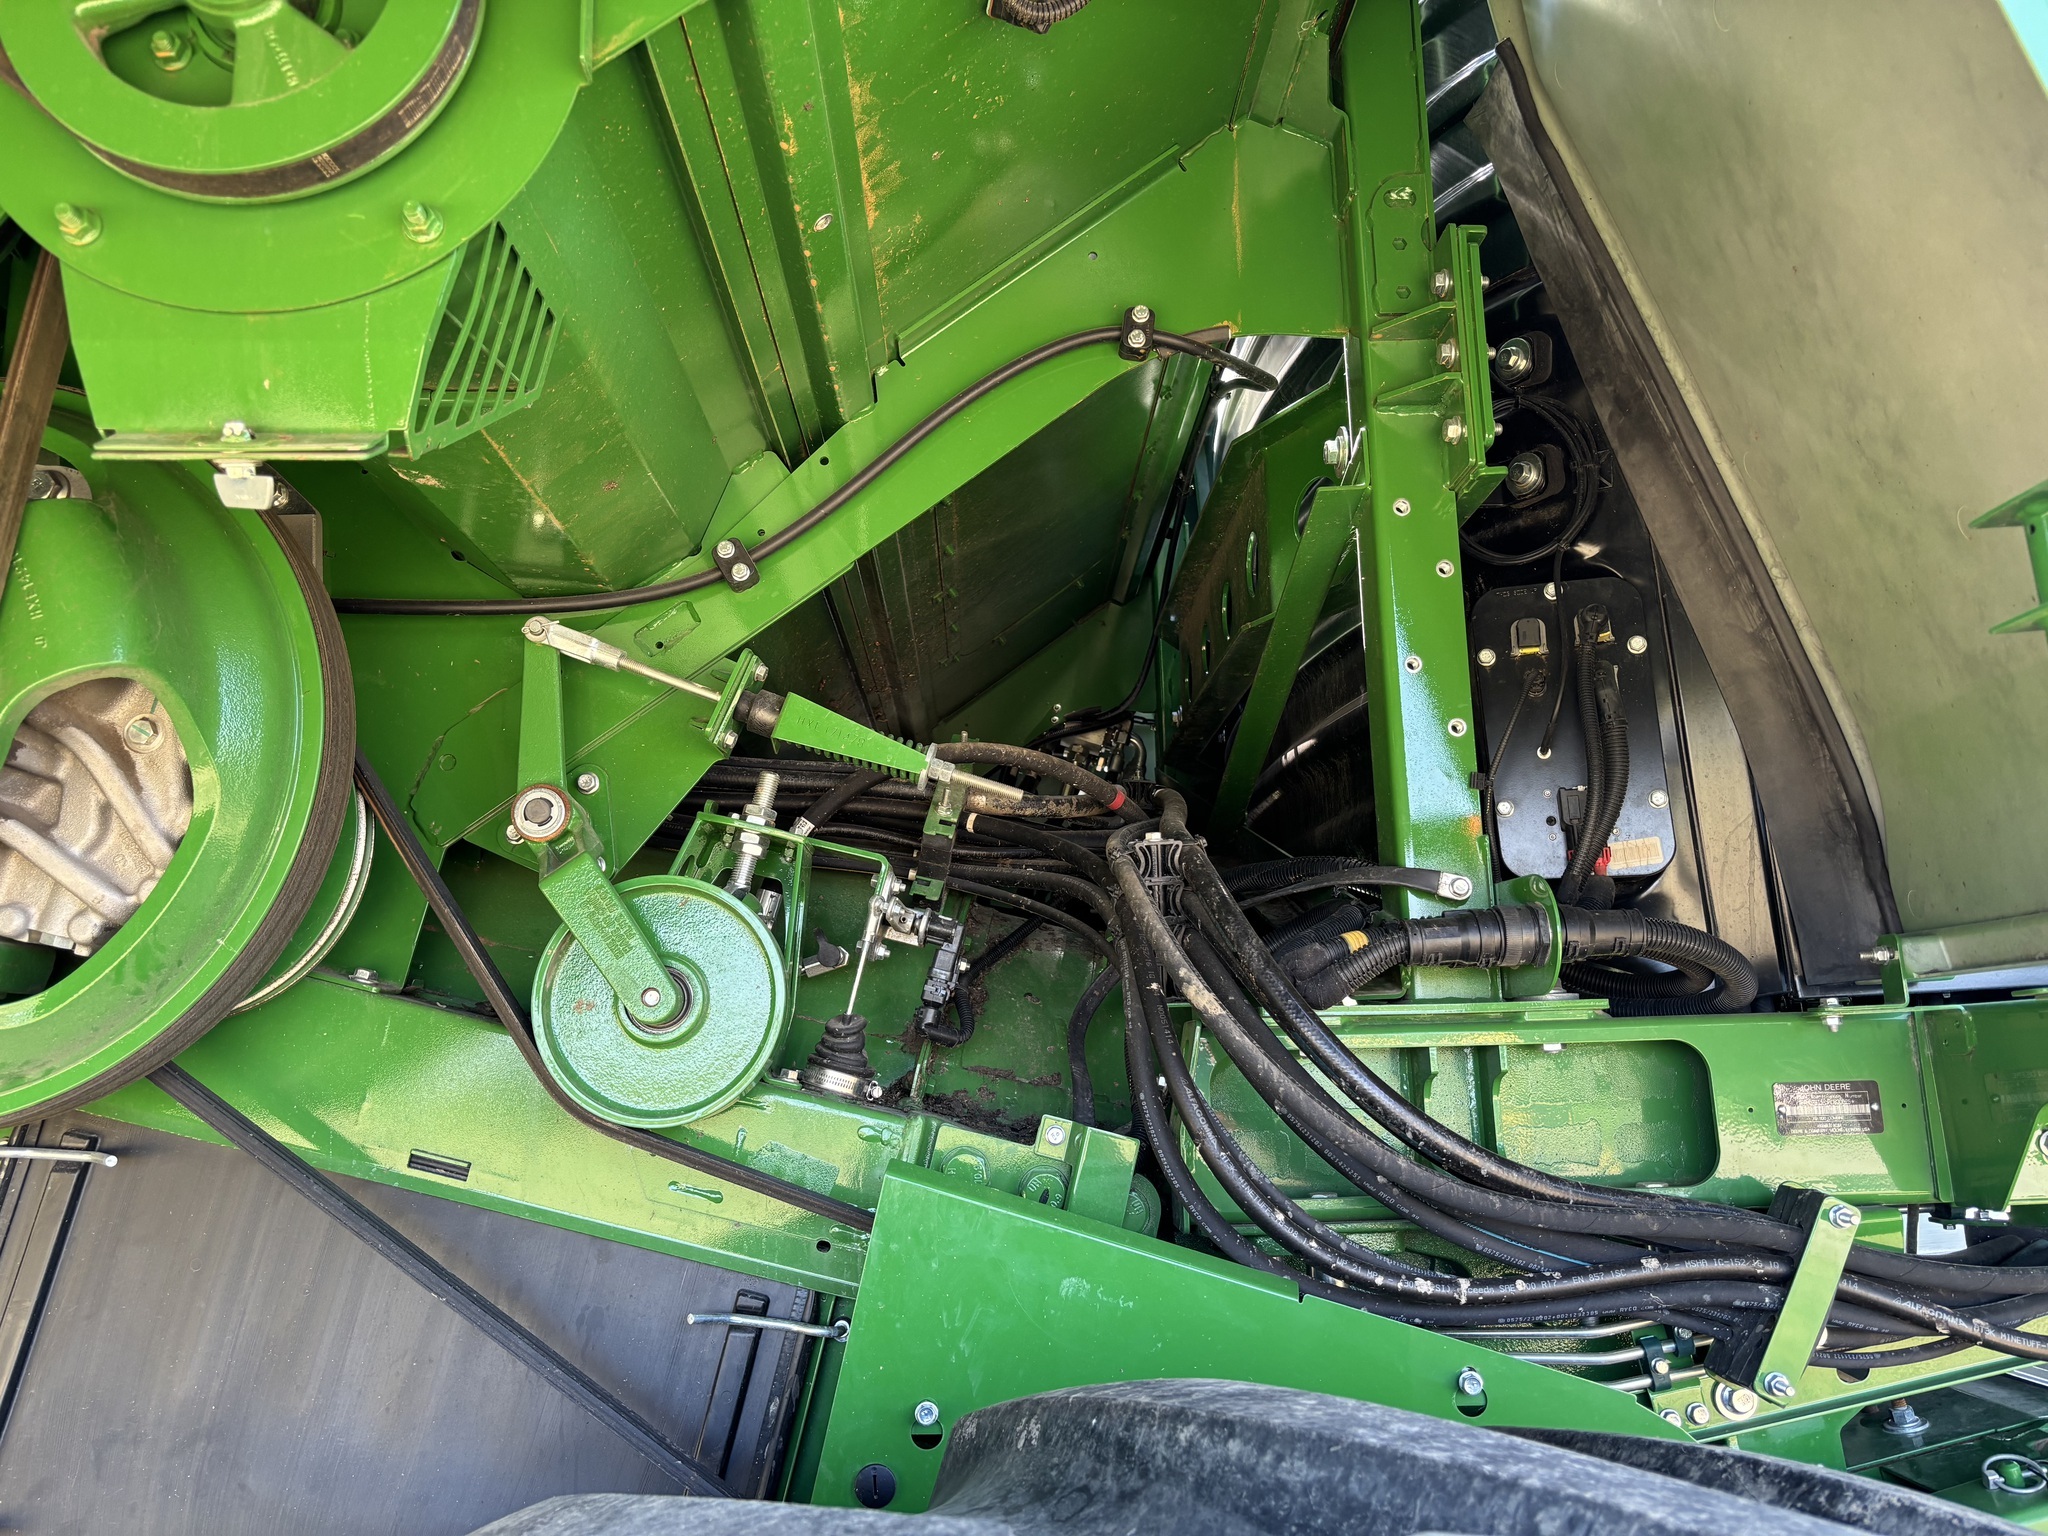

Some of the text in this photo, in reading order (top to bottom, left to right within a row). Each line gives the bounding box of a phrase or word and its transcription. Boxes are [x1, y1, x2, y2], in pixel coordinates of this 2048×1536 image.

[1801, 1083, 1851, 1092] JOHN DEERE
[1287, 1113, 1323, 1148] 0575/231202
[1378, 1191, 1395, 1205] RYCO
[1184, 1087, 1218, 1149] ALFAGOMMA
[1541, 1279, 1557, 1288] R17
[1572, 1275, 1585, 1283] EN
[1589, 1272, 1604, 1282] 857
[1188, 1204, 1202, 1221] RYCO
[1619, 1306, 1638, 1314] RYCO
[1897, 1299, 1968, 1329] ALFAGOMMA
[2000, 1331, 2048, 1350] MINETUFF-
